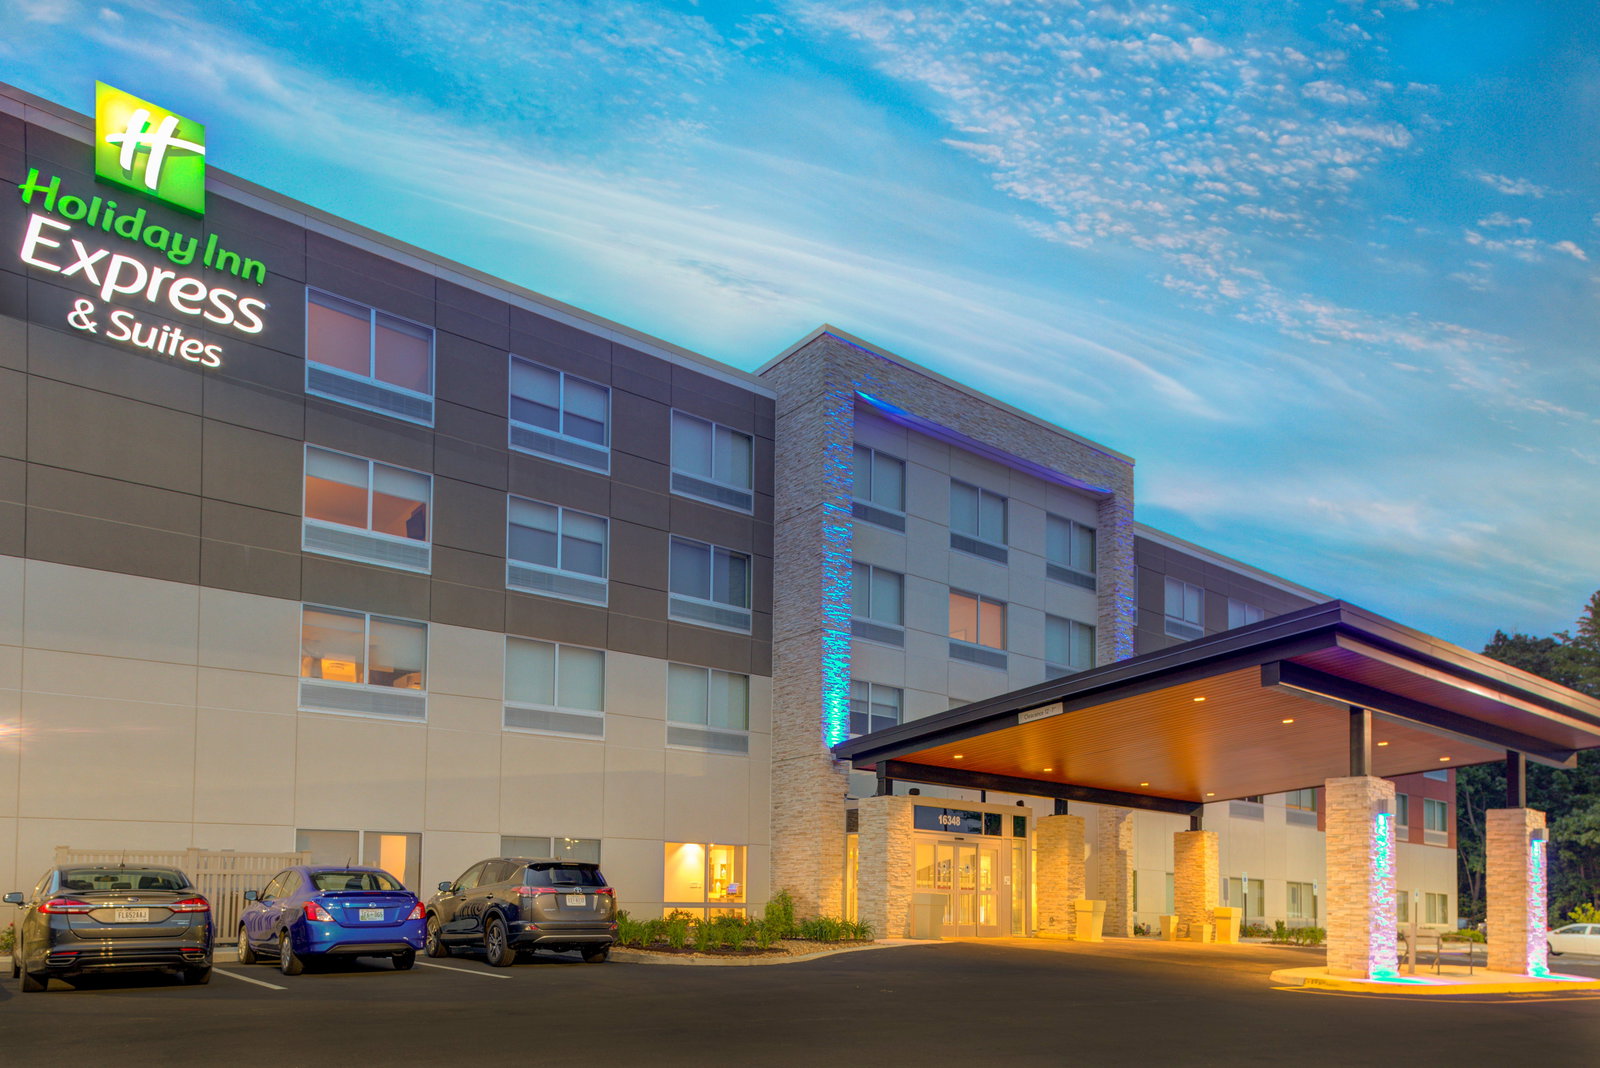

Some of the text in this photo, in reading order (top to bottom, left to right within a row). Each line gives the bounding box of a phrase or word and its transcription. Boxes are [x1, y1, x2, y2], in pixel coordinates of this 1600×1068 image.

[18, 167, 267, 286] Holiday Inn
[20, 213, 267, 334] Express
[66, 298, 223, 368] & Suites
[938, 814, 961, 826] 16348
